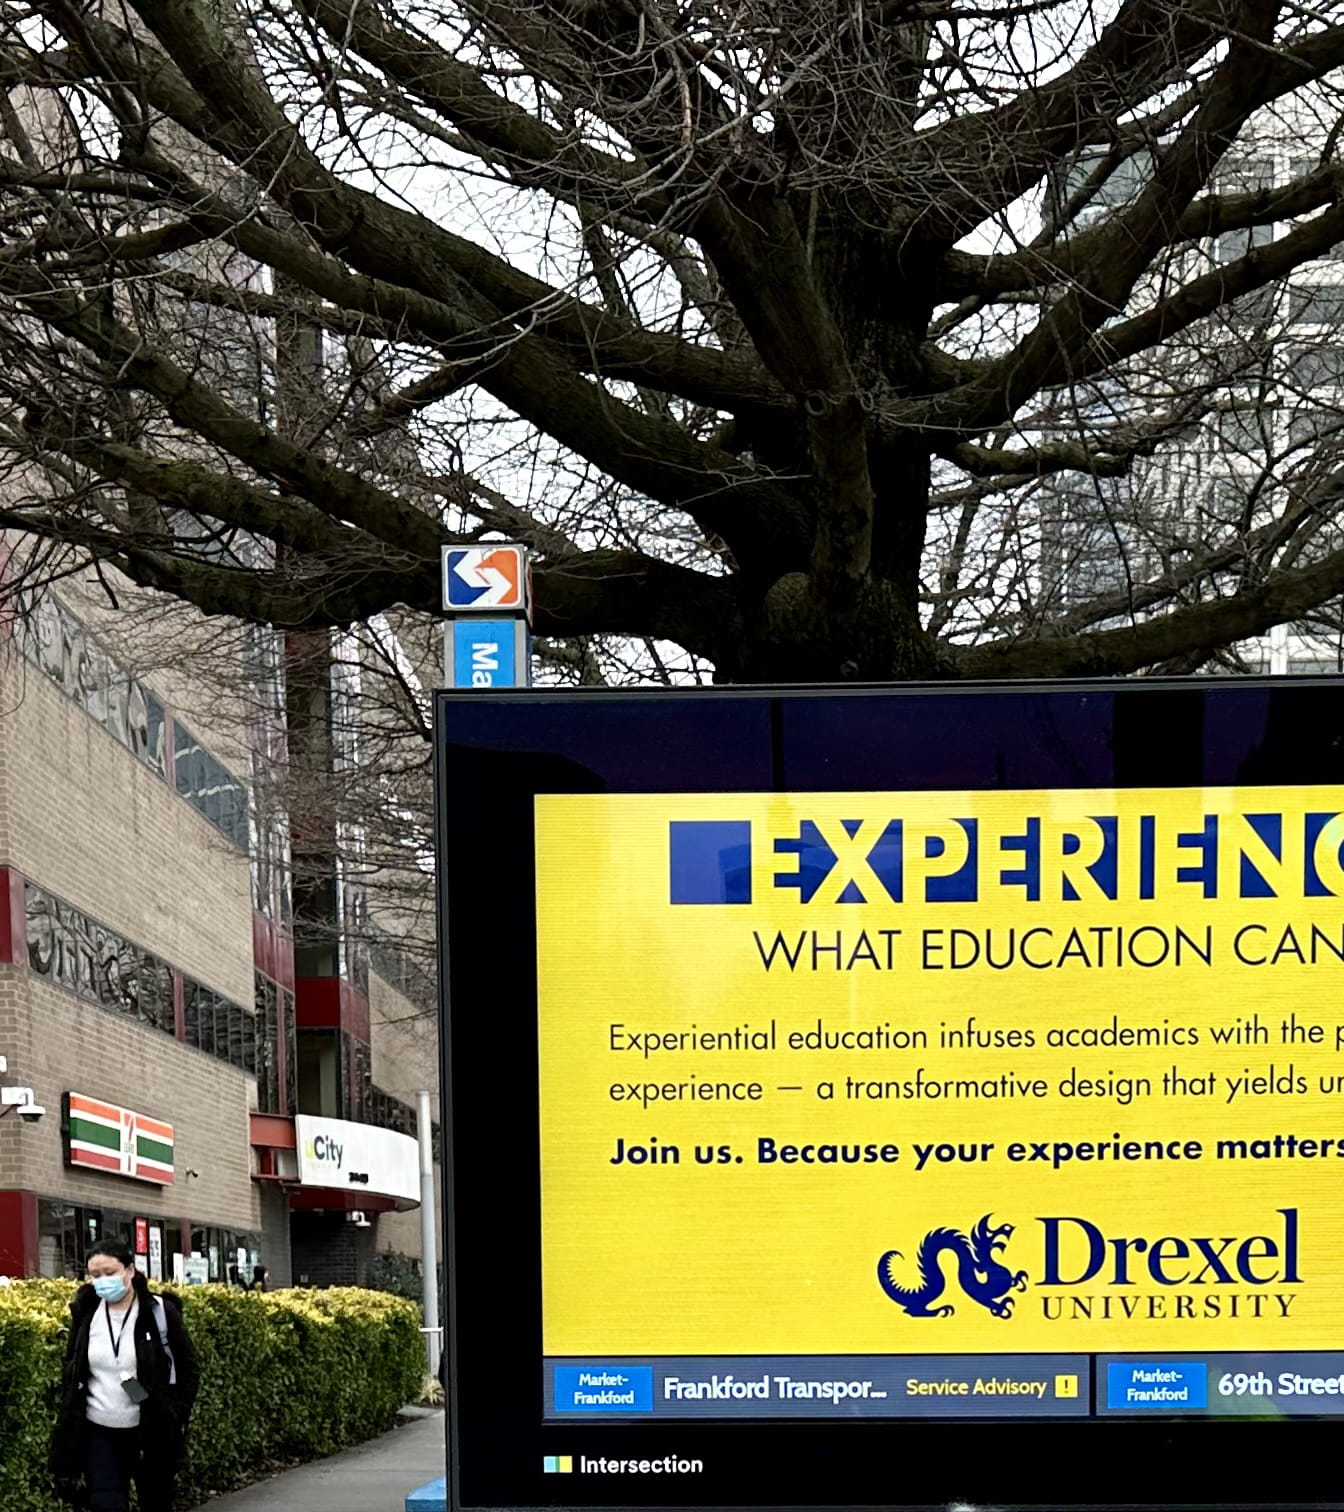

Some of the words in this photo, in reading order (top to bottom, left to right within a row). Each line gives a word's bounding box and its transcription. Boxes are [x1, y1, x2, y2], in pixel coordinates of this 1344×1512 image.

[753, 929, 902, 972] WHAT
[922, 925, 1212, 970] EDUCATION
[610, 1019, 776, 1059] Experiential
[788, 1018, 927, 1050] education
[940, 1016, 1036, 1048] infuses
[1046, 1015, 1199, 1047] academics
[1209, 1013, 1268, 1045] with
[1281, 1013, 1324, 1044] the
[609, 1074, 763, 1109] experience
[816, 1082, 834, 1100] a
[846, 1068, 1048, 1100] transformative
[1058, 1066, 1151, 1105] design
[1162, 1065, 1217, 1096] that
[1225, 1063, 1308, 1104] yields
[304, 1135, 343, 1169] uCity
[609, 1136, 680, 1165] Join
[694, 1145, 743, 1165] us.
[757, 1137, 900, 1164] Because
[912, 1143, 995, 1171] your
[1006, 1132, 1203, 1170] experience
[1035, 1208, 1304, 1286] Drexel
[1042, 1294, 1296, 1320] UNIVERSITY
[578, 1372, 629, 1386] Market-
[664, 1374, 770, 1400] Frankford
[906, 1378, 969, 1396] Service
[972, 1377, 1048, 1400] Advisory
[1132, 1368, 1183, 1384] Market-
[1218, 1371, 1273, 1397] 69th
[573, 1390, 635, 1405] Frankford
[1126, 1386, 1188, 1402] Frankford
[580, 1454, 704, 1475] Intersection
